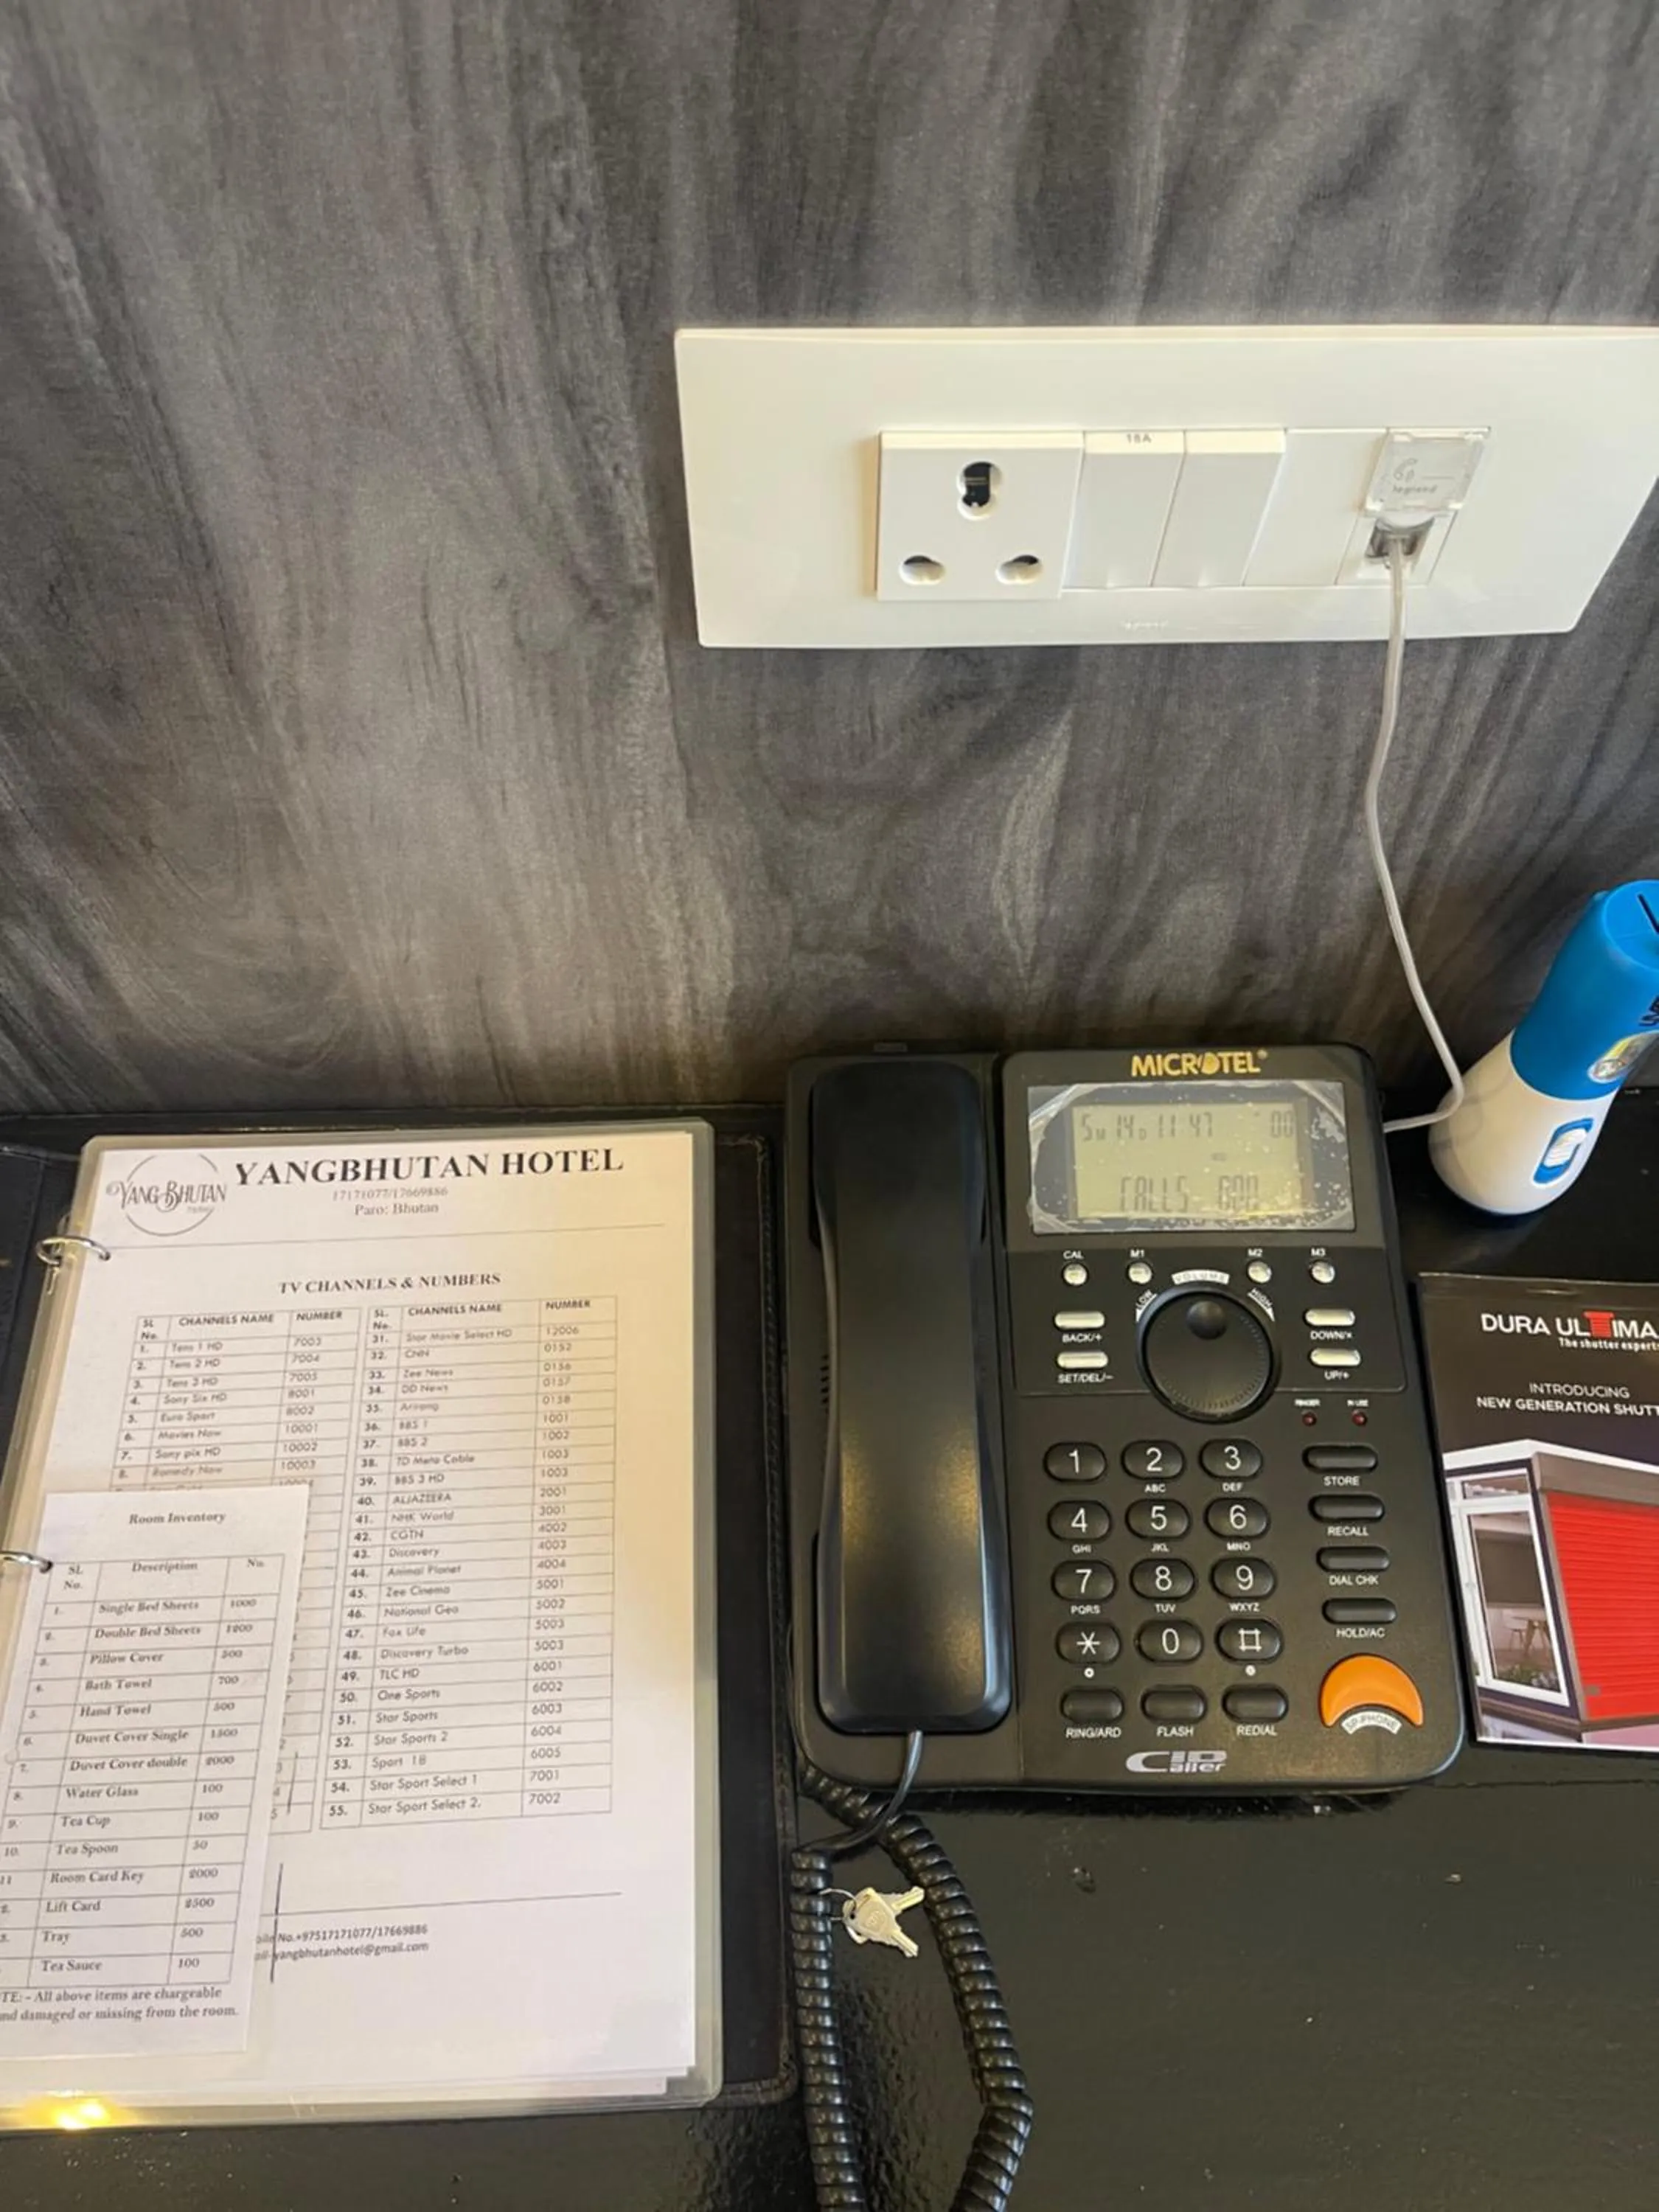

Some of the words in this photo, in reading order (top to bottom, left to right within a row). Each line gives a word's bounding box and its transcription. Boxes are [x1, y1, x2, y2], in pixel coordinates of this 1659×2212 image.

[236, 1154, 490, 1186] YANGBHUTAN
[501, 1148, 624, 1175] HOTEL
[355, 1204, 388, 1216] Paro:
[393, 1203, 439, 1214] Bhutan
[1063, 1251, 1083, 1259] CAL
[1130, 1250, 1144, 1258] M1
[1248, 1249, 1262, 1257] M2
[1311, 1248, 1326, 1256] M3
[279, 1281, 301, 1295] TV
[306, 1276, 397, 1293] CHANNELS
[400, 1276, 413, 1288] &
[419, 1273, 501, 1287] NUMBERS
[1136, 1290, 1152, 1310] LOW
[1251, 1288, 1273, 1308] HIGH
[408, 1305, 466, 1317] CHANNELS
[469, 1304, 501, 1313] NAME
[546, 1300, 591, 1310] NUMBER
[178, 1317, 237, 1326] CHANNELS
[240, 1314, 274, 1324] NAME
[296, 1311, 343, 1321] NUMBER
[1481, 1312, 1551, 1335] DURA
[1559, 1338, 1577, 1347] The
[1580, 1339, 1618, 1349] shutter
[1529, 1382, 1630, 1398] INTRODUCING
[1476, 1397, 1511, 1409] NEW
[1515, 1399, 1610, 1414] GENERATION
[1068, 1450, 1080, 1472] 1
[1146, 1447, 1163, 1472] 2
[1224, 1446, 1241, 1470] 3
[1222, 1483, 1242, 1491] DEF
[1324, 1476, 1360, 1486] STORE
[1145, 1484, 1166, 1492] ABC
[129, 1513, 164, 1524] Room
[168, 1512, 226, 1524] Inventory
[1071, 1508, 1088, 1532] 4
[1150, 1506, 1167, 1530] 5
[1230, 1505, 1247, 1528] 6
[1328, 1526, 1369, 1537] RECALL
[1073, 1544, 1091, 1553] GHI
[1152, 1544, 1169, 1552] JKL
[1227, 1542, 1251, 1551] MNO
[389, 1548, 439, 1559] Discovery
[131, 1561, 198, 1573] Description
[388, 1567, 425, 1577] Animal
[428, 1565, 462, 1575] Planet
[1075, 1569, 1092, 1593] 7
[1155, 1566, 1172, 1590] 8
[1236, 1565, 1253, 1590] 9
[1329, 1576, 1354, 1585] DIAL
[1356, 1575, 1379, 1585] CHK
[99, 1604, 134, 1614] Single
[137, 1602, 159, 1612] Bed
[162, 1600, 199, 1611] Sheets
[1071, 1604, 1100, 1615] PQRS
[1155, 1604, 1175, 1612] TUV
[1229, 1602, 1259, 1612] WXYZ
[95, 1627, 136, 1639] Double
[139, 1627, 161, 1637] Bed
[164, 1626, 201, 1635] Sheets
[1336, 1627, 1385, 1638] HOLD/AC
[1162, 1629, 1179, 1653] 0
[90, 1653, 127, 1664] Pillow
[130, 1652, 164, 1663] Cover
[380, 1648, 433, 1660] Discovery
[437, 1645, 469, 1656] Turbo
[380, 1669, 400, 1680] TLC
[403, 1668, 420, 1678] HD
[86, 1680, 112, 1691] Bath
[116, 1679, 152, 1689] Towel
[378, 1690, 401, 1701] One
[406, 1689, 440, 1700] Sports
[80, 1706, 111, 1717] Hand
[116, 1705, 152, 1715] Towel
[532, 1703, 563, 1714] 6003
[375, 1712, 399, 1723] Star
[403, 1711, 438, 1722] Sports
[1066, 1726, 1121, 1739] RING/ARD
[1157, 1726, 1194, 1737] FLASH
[1237, 1725, 1277, 1736] REDIAL
[74, 1732, 111, 1744] Duvet
[114, 1732, 149, 1742] Cover
[152, 1730, 189, 1741] Single
[374, 1734, 397, 1745] Star
[400, 1733, 437, 1745] Sports
[441, 1731, 448, 1742] 2
[70, 1759, 106, 1771] Duvet
[109, 1759, 144, 1770] Cover
[147, 1757, 188, 1768] double
[372, 1756, 403, 1769] Sport
[530, 1770, 560, 1781] 7001
[202, 1784, 223, 1794] 100
[370, 1780, 394, 1791] Star
[397, 1778, 429, 1789] Sport
[433, 1775, 467, 1787] Select
[66, 1786, 102, 1798] Water
[105, 1786, 139, 1797] Glass
[529, 1792, 561, 1804] 7002
[368, 1802, 392, 1814] Star
[395, 1801, 428, 1812] Sport
[431, 1799, 466, 1810] Select
[60, 1816, 83, 1827] Tea
[87, 1815, 111, 1828] Cup
[197, 1812, 220, 1822] 100
[57, 1843, 77, 1855] Tea
[81, 1843, 119, 1855] Spoon
[50, 1872, 86, 1883] Room
[88, 1871, 118, 1882] Card
[121, 1870, 144, 1883] Key
[46, 1902, 68, 1913] Lift
[72, 1900, 101, 1912] Card
[42, 1931, 70, 1944] Tray
[41, 1961, 64, 1971] Tea
[66, 1960, 102, 1972] Sauce
[178, 1958, 200, 1968] 100
[35, 1992, 52, 2002] All
[55, 1992, 91, 2002] above
[94, 1991, 128, 2001] items
[131, 1991, 151, 2000] are
[154, 1987, 222, 2003] chargeable
[21, 2009, 75, 2023] damaged
[78, 2009, 92, 2020] or
[95, 2008, 142, 2022] missing
[147, 2006, 175, 2017] from
[179, 2006, 199, 2017] the
[202, 2006, 240, 2017] room.
